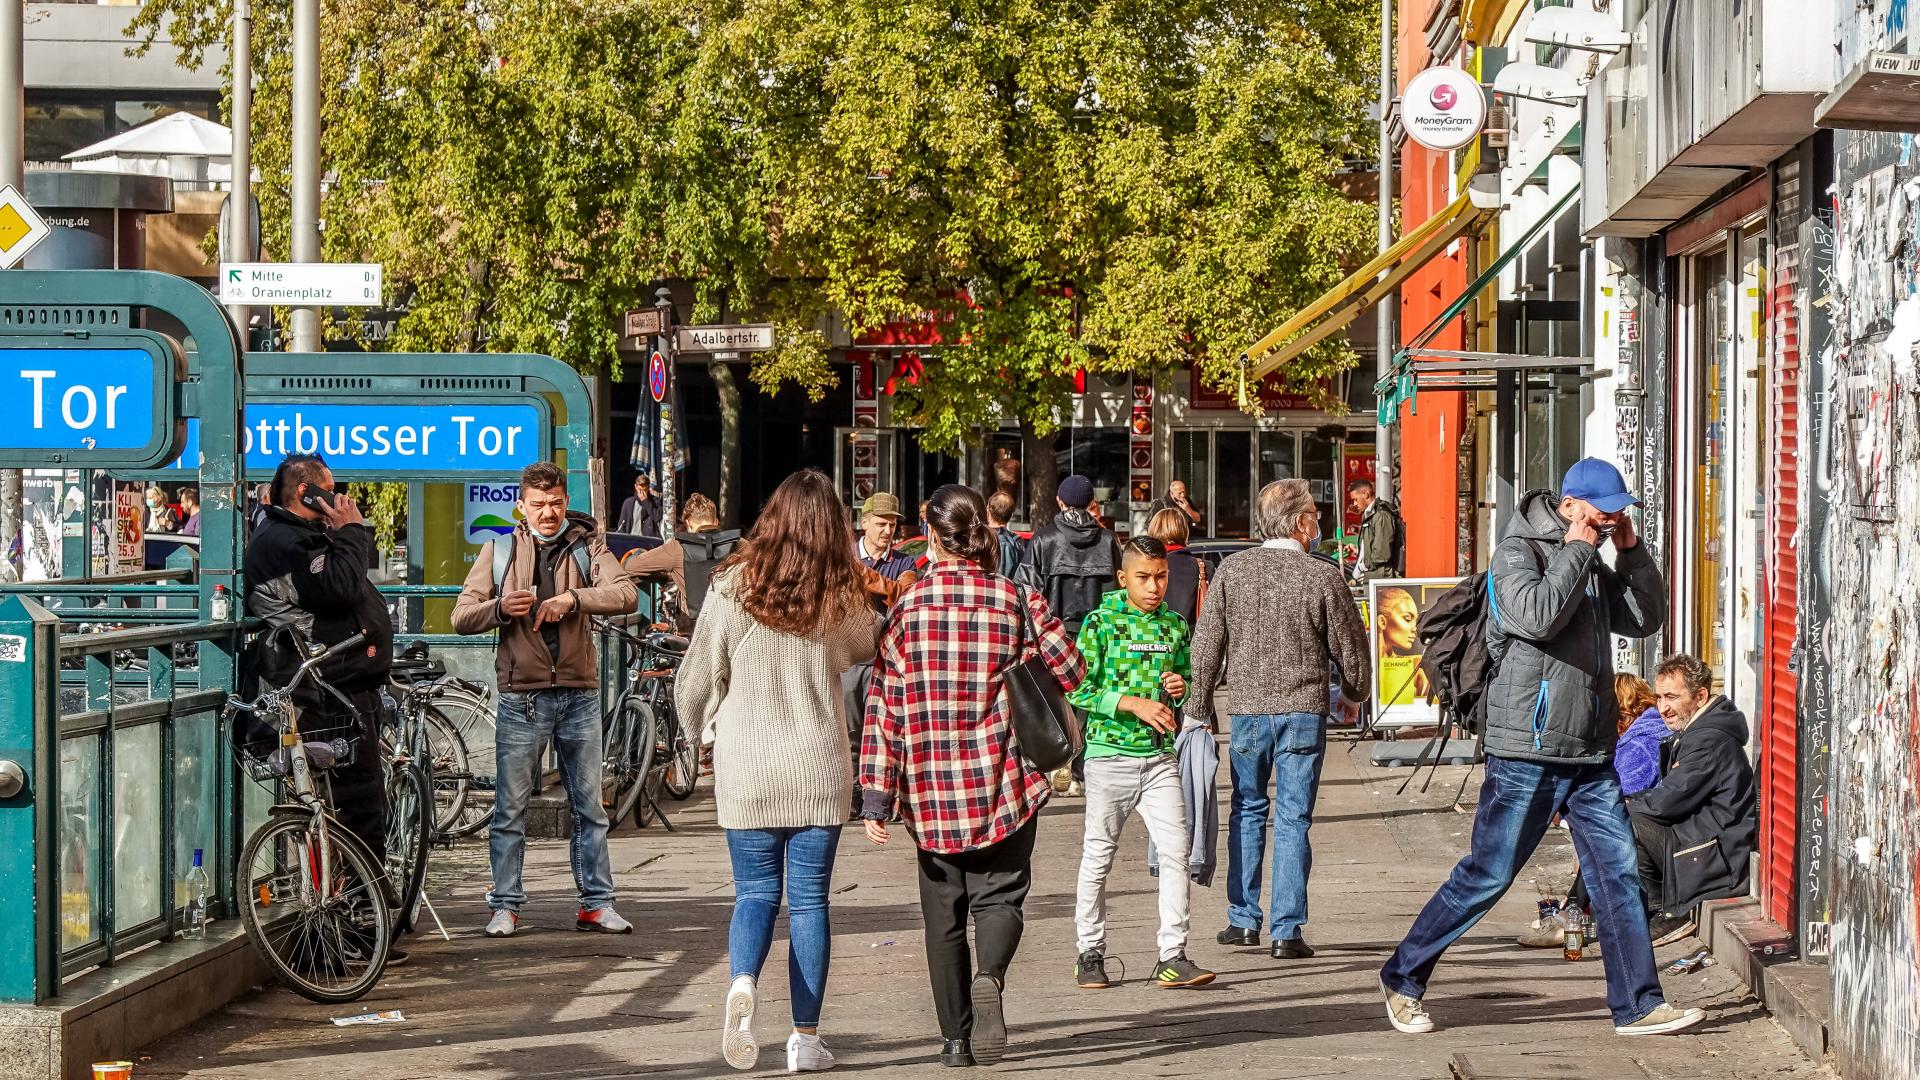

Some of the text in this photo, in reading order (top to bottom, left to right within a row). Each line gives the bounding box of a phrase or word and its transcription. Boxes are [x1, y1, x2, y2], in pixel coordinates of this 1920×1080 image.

[1875, 58, 1900, 70] NEW
[1415, 117, 1472, 126] MoneyGram
[252, 270, 283, 281] Mitte
[252, 287, 332, 300] Oranienplatz
[692, 331, 760, 345] Adalbertstr.
[20, 370, 128, 430] Tor
[452, 416, 522, 456] Tor
[118, 494, 132, 506] KLI
[117, 507, 131, 518] MA
